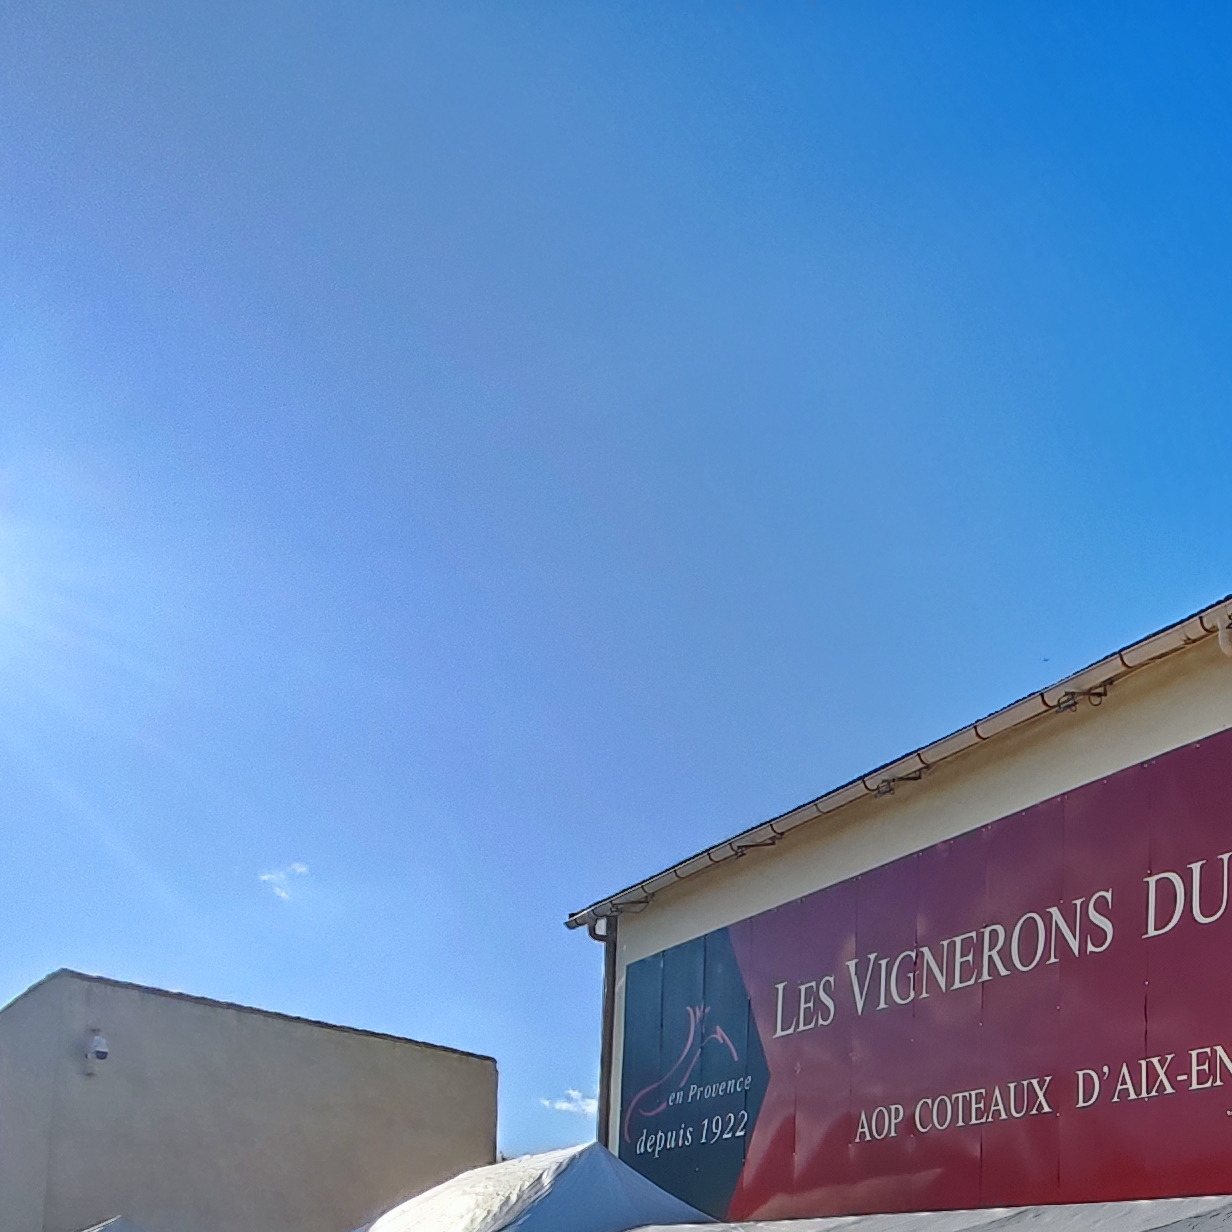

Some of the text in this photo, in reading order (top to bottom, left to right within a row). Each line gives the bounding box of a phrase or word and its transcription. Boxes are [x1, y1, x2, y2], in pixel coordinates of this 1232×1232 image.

[772, 975, 835, 1039] LES
[844, 887, 1114, 1015] VIGNERONS
[668, 1075, 752, 1106] en Provence
[855, 1103, 904, 1143] AOP
[914, 1075, 1053, 1133] COTEAUX
[636, 1109, 748, 1159] depuis 1922
